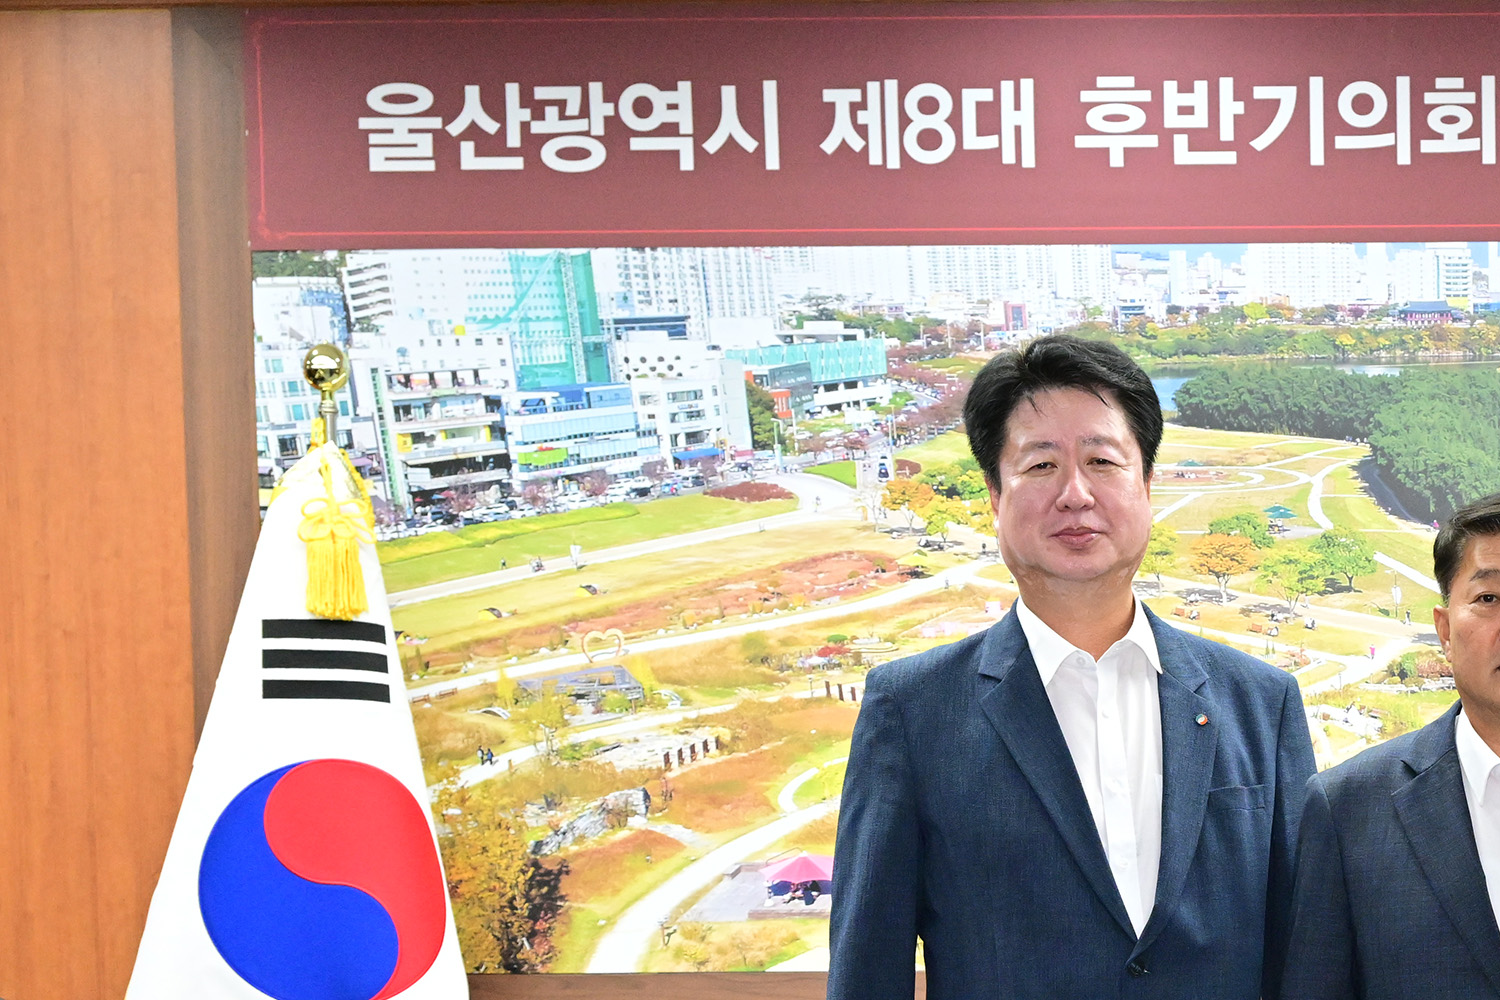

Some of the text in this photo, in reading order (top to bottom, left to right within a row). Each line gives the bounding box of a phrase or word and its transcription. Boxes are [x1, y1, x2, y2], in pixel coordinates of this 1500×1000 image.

[358, 79, 780, 173] 울산광역시
[819, 77, 1036, 170] 제8대
[1074, 75, 1497, 168] 후반기의회
